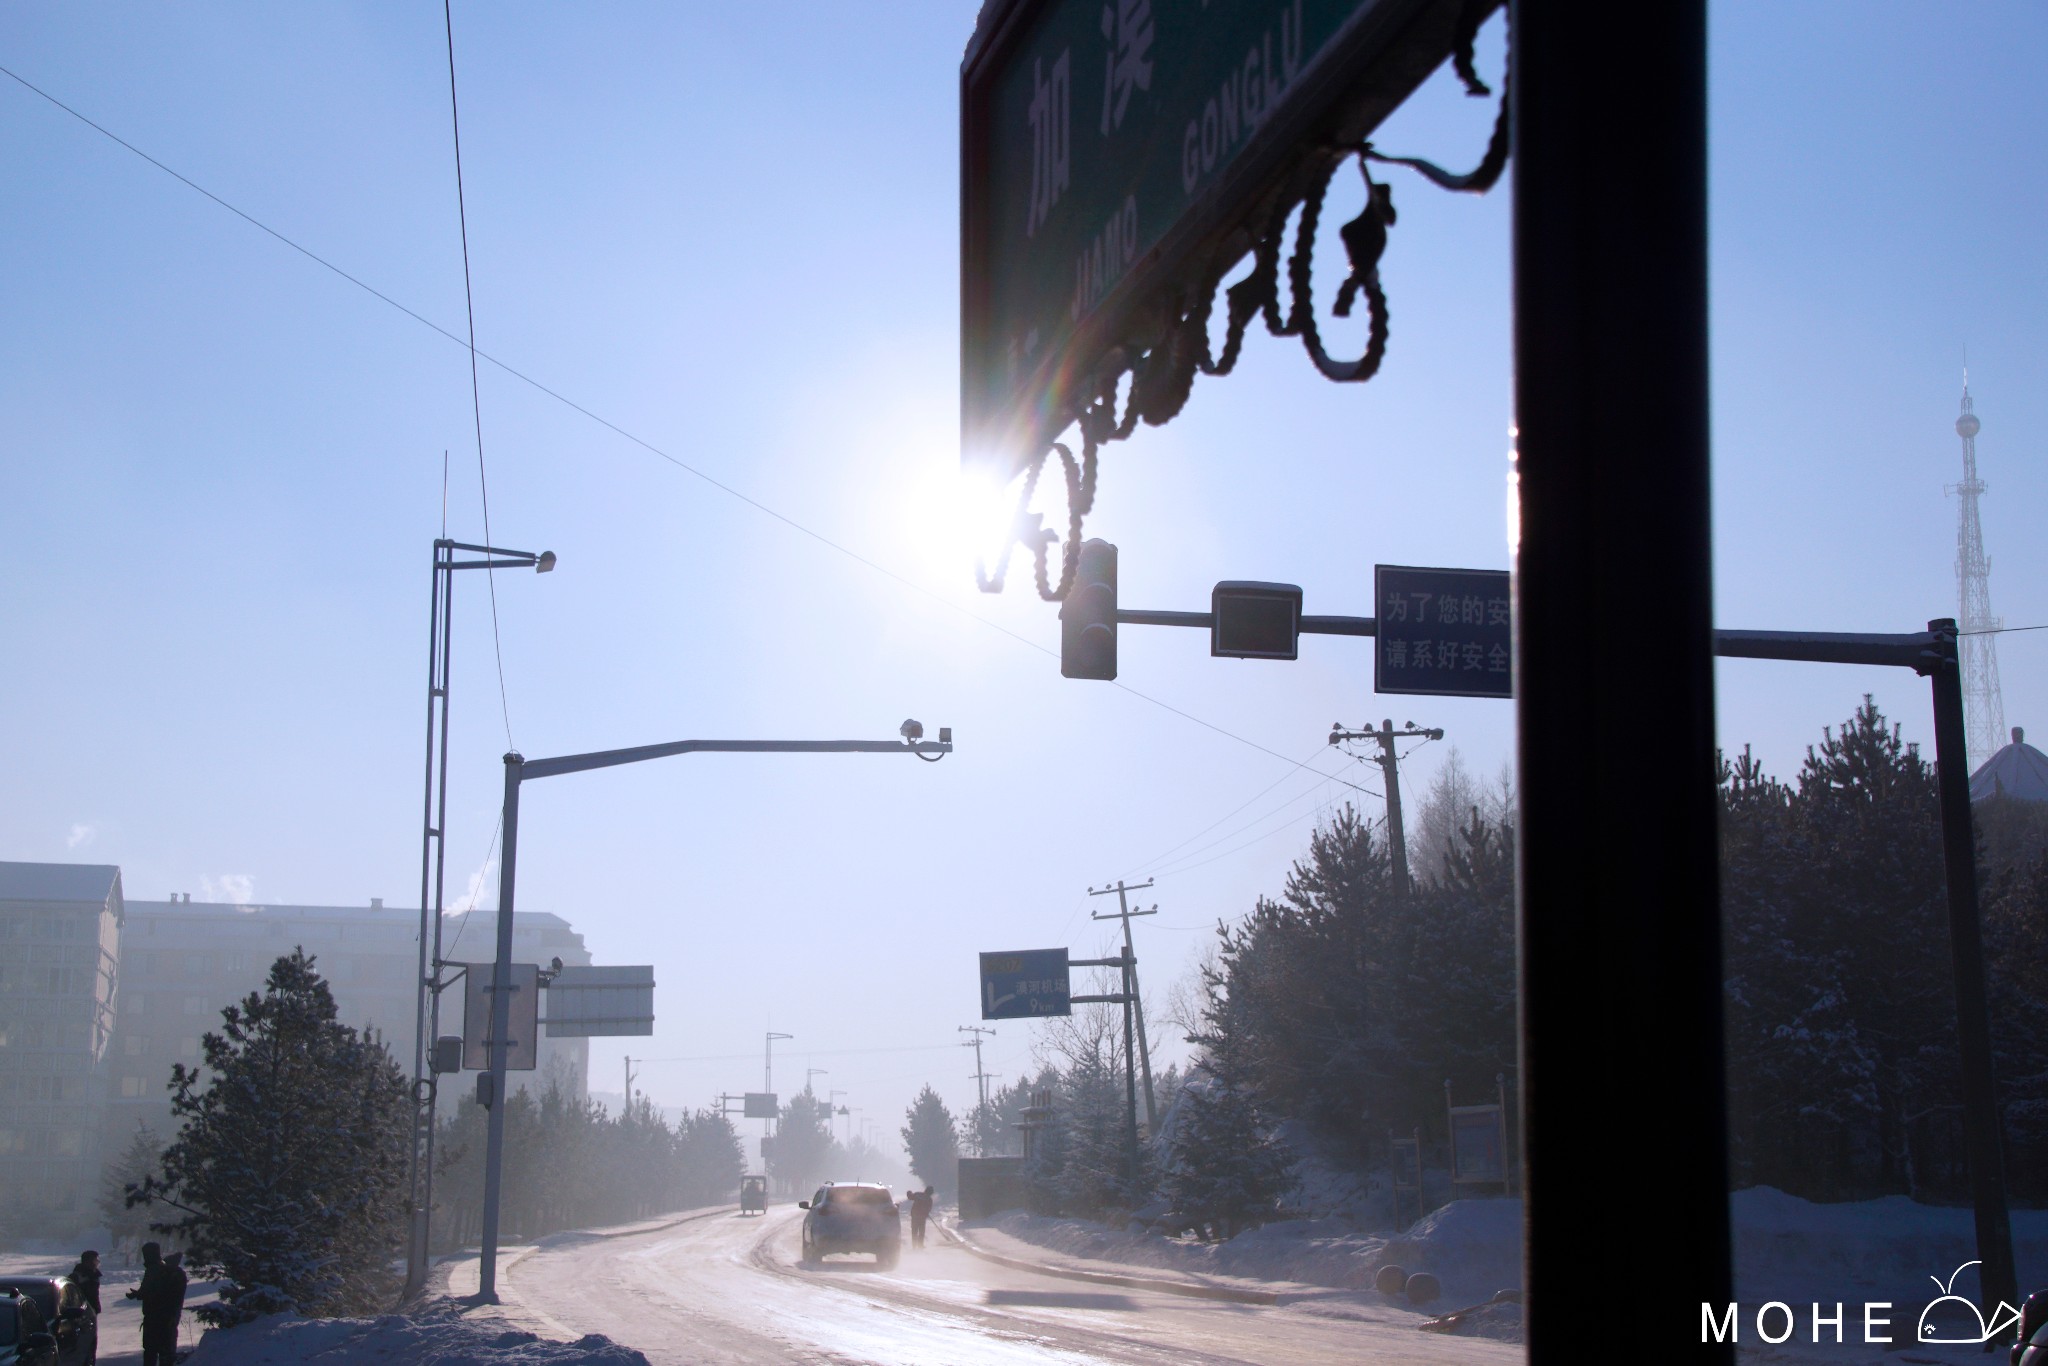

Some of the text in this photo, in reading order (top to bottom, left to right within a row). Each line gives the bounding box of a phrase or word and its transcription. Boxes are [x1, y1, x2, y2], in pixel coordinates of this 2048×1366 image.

[1071, 0, 1302, 321] JIAMO GONGLU
[1386, 591, 1509, 626] 为了您的安
[1386, 638, 1508, 672] 请系好安全
[1017, 979, 1067, 995] 漠河机场
